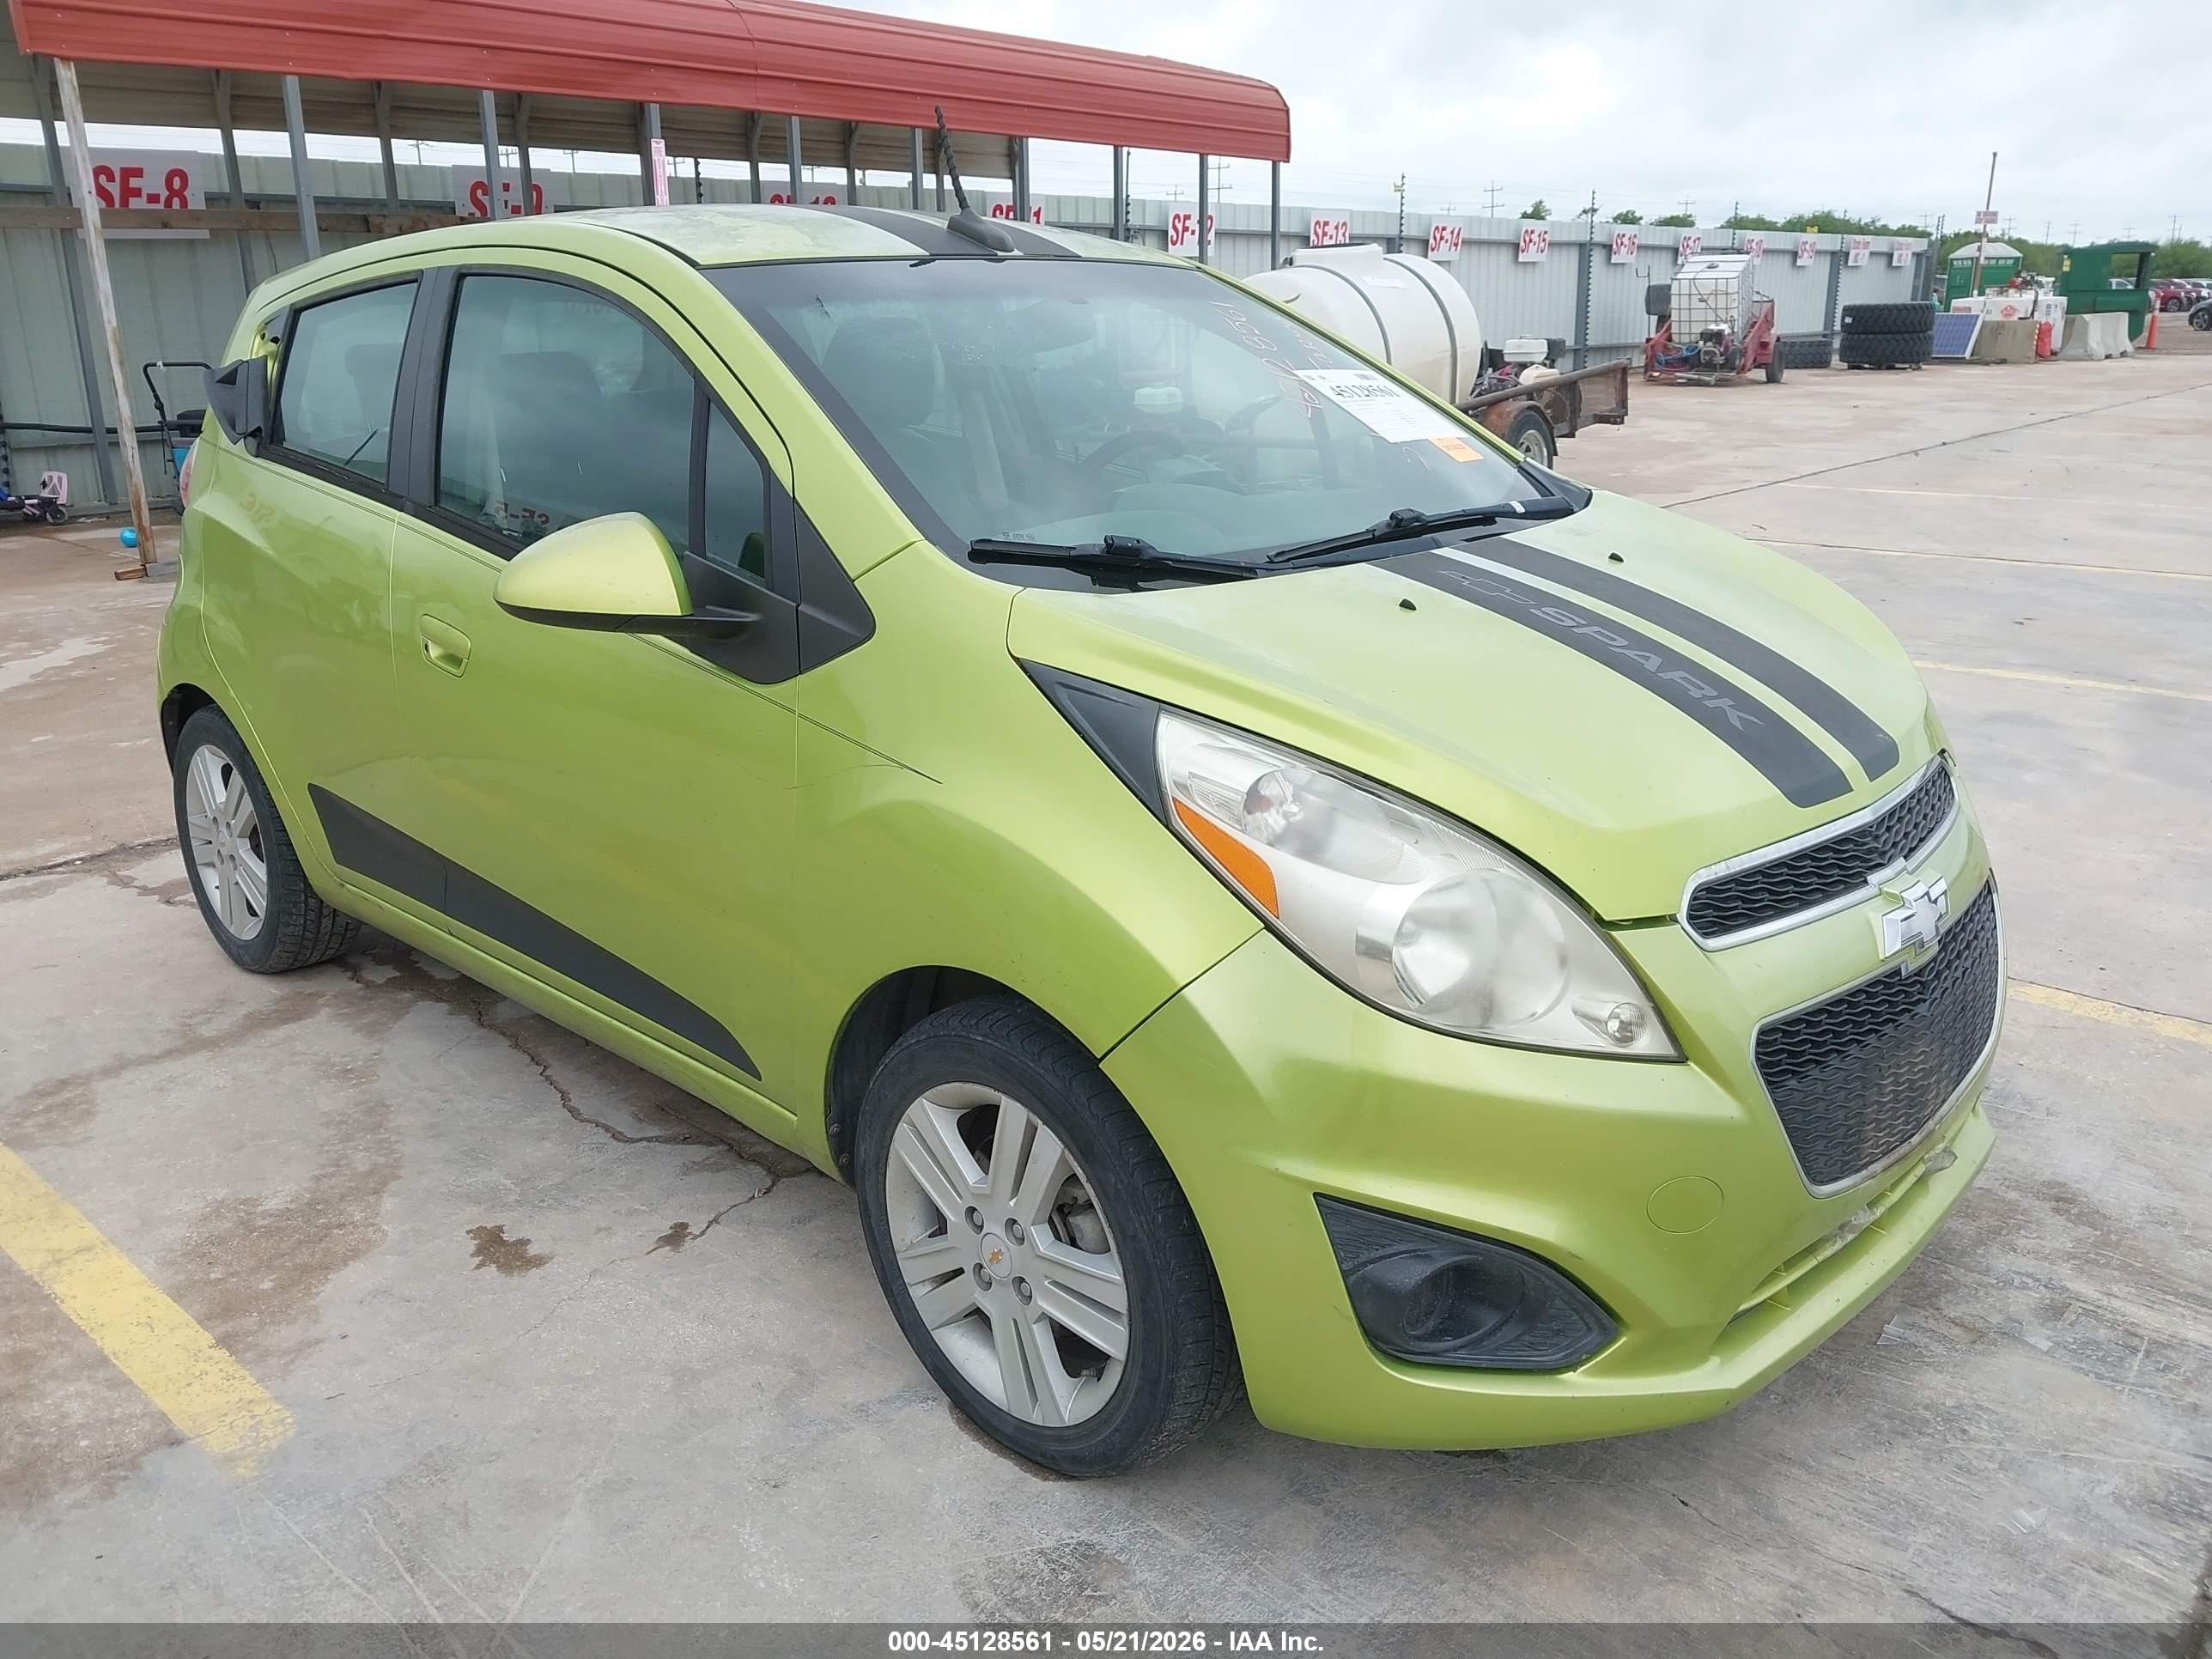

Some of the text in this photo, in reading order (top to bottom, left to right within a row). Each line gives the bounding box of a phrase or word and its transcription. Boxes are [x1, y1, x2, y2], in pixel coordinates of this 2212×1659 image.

[92, 164, 189, 209] SF-8
[1313, 220, 1348, 246] SF-13
[1430, 225, 1462, 252] SF-14
[1521, 229, 1548, 253] SF-15
[1613, 233, 1637, 255] SF-16
[1329, 385, 1401, 399] 45128561
[1528, 606, 1766, 732] SPARK
